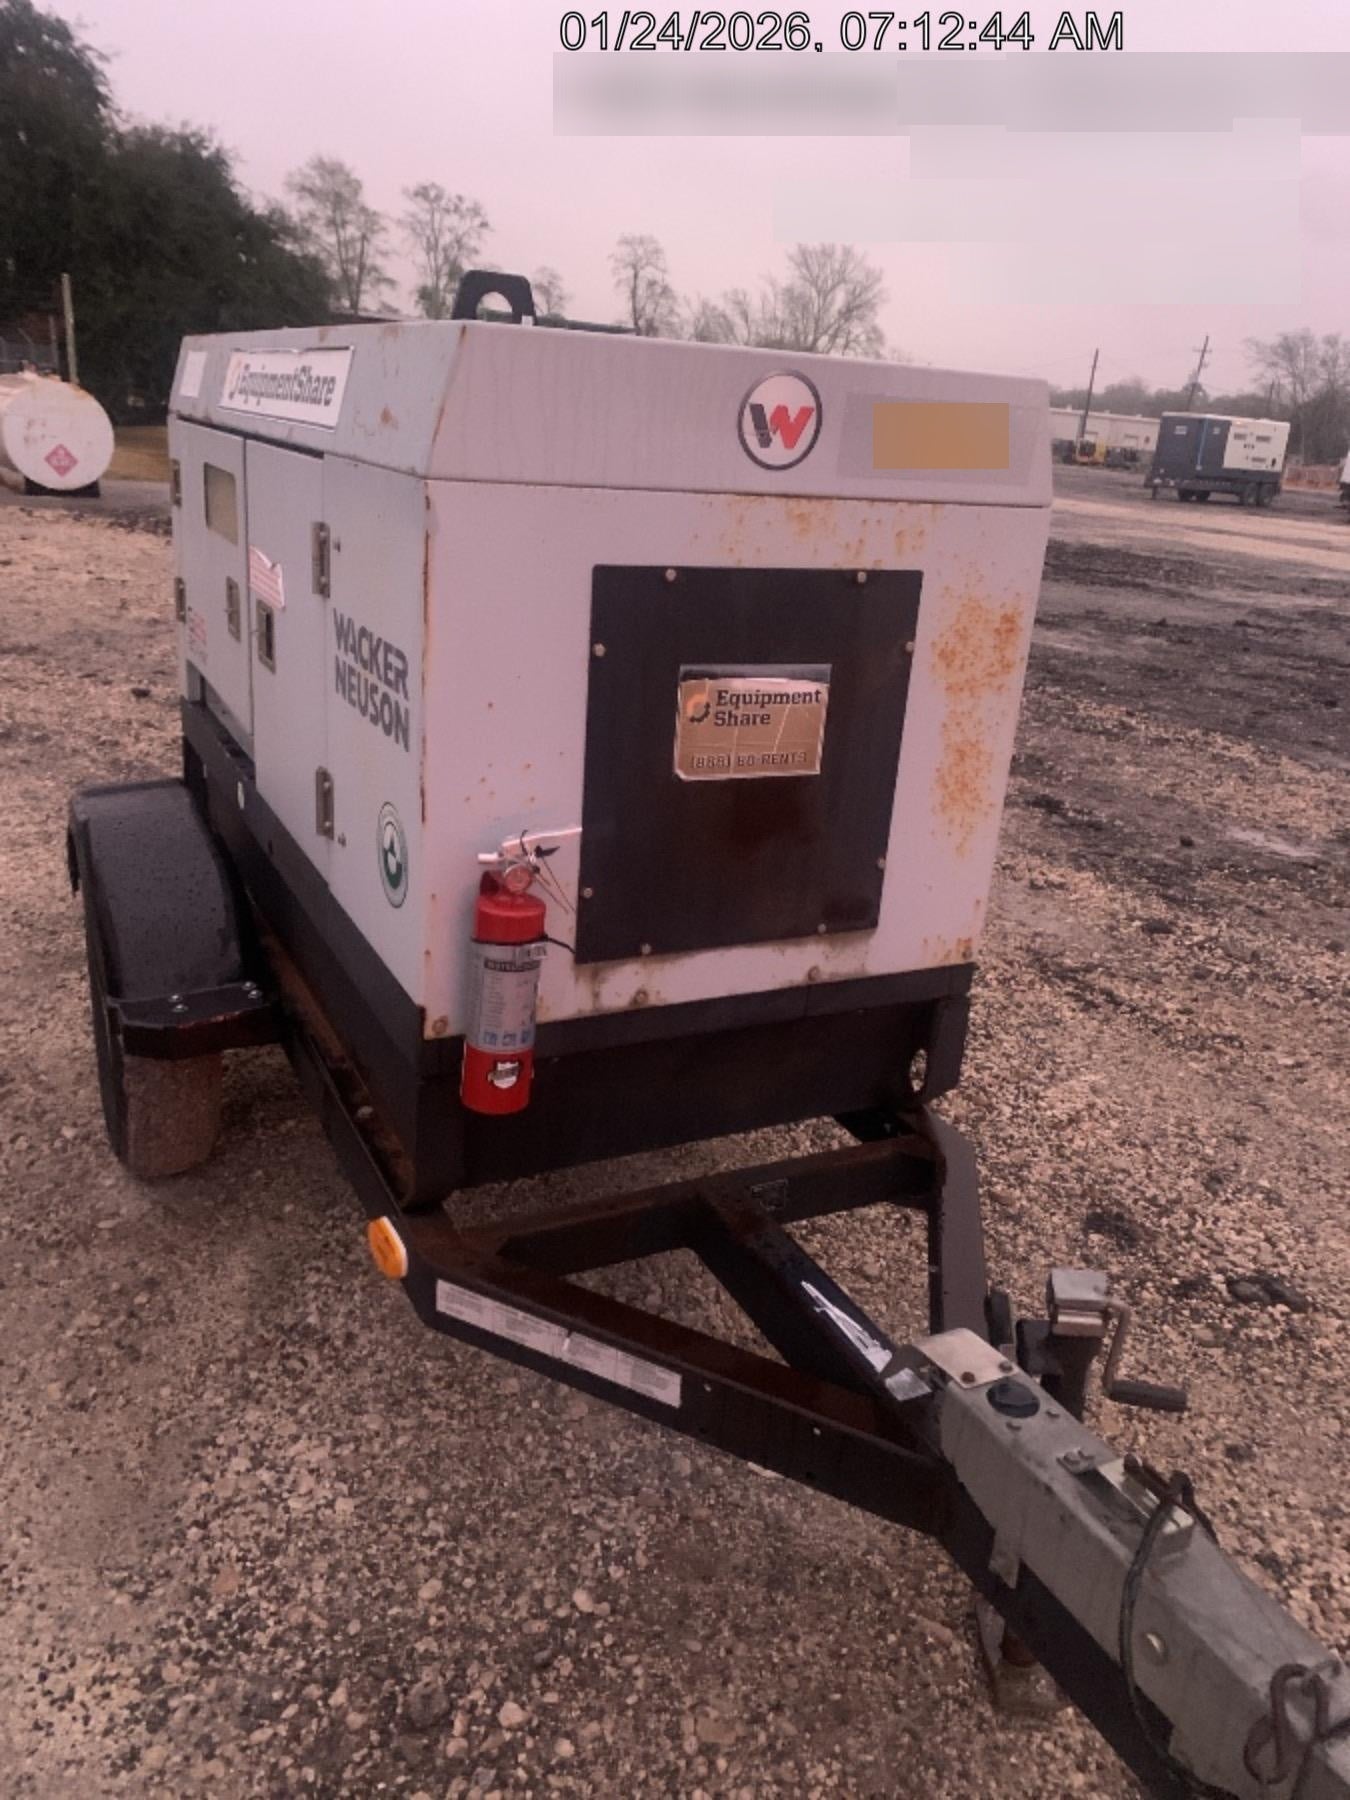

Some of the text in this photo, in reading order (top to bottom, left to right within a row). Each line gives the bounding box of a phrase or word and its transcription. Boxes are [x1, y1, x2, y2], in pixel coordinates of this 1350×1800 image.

[238, 363, 337, 406] EquipmentShare
[333, 607, 409, 701] WACKER
[335, 654, 410, 752] NEUSON
[714, 711, 771, 727] Share
[716, 689, 822, 709] Equipment
